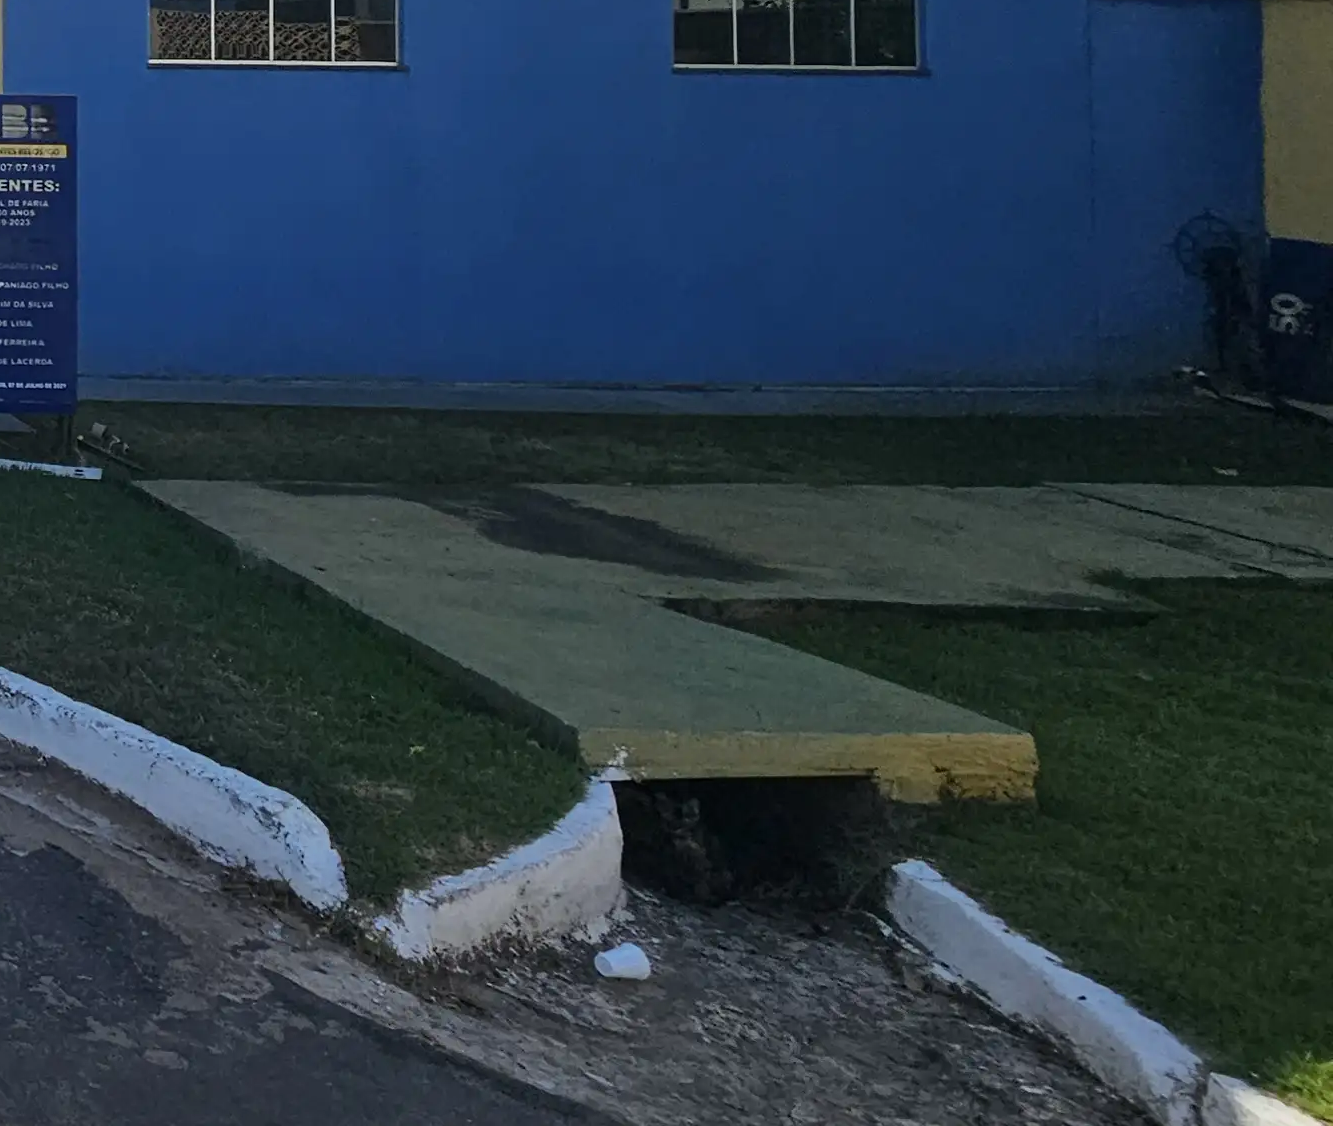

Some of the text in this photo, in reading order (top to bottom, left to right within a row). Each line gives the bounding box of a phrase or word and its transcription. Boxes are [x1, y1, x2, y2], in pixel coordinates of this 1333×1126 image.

[10, 209, 36, 217] ANOS
[42, 282, 70, 290] FILHO
[13, 300, 25, 308] DA
[28, 301, 54, 309] SILVA
[11, 358, 54, 366] LACERDA
